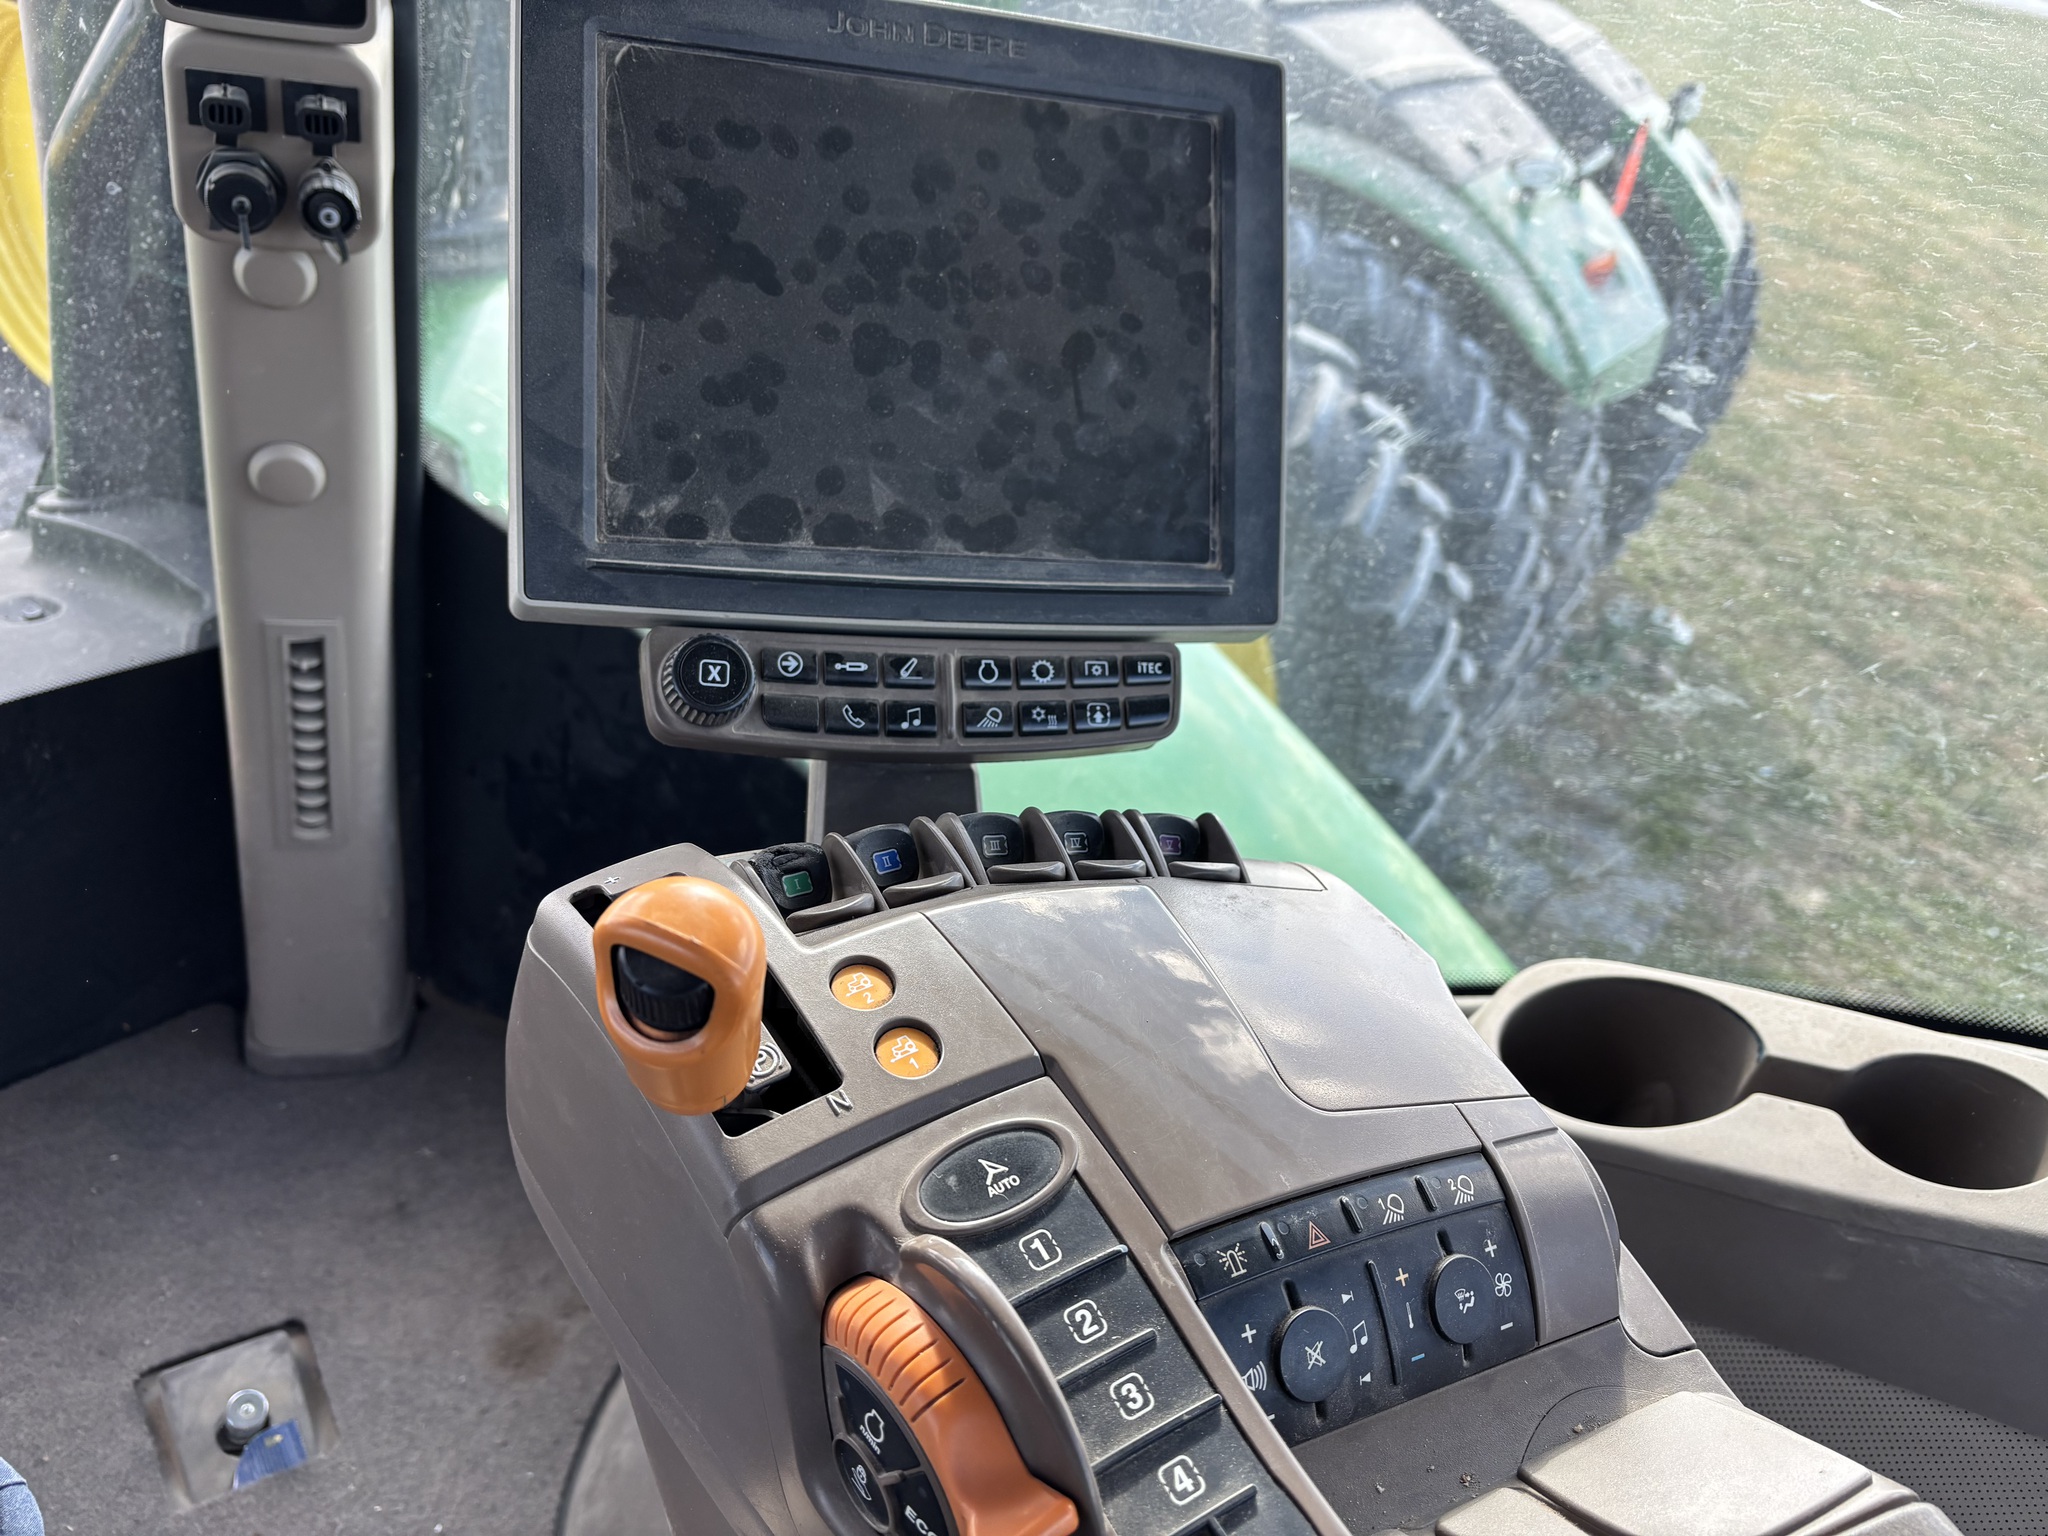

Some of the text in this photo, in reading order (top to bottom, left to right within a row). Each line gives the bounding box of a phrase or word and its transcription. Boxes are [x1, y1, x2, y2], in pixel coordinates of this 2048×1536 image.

[827, 10, 915, 43] JOHN
[881, 855, 892, 868] II
[863, 991, 875, 1004] 2
[909, 1057, 919, 1069] 1
[826, 1089, 854, 1117] N
[987, 1175, 1020, 1198] AUTO
[1447, 1178, 1457, 1191] 2
[1378, 1197, 1386, 1210] 1
[1030, 1237, 1051, 1261] 1
[1074, 1309, 1100, 1336] 2
[1121, 1382, 1144, 1410] 3
[1173, 1464, 1195, 1493] 4
